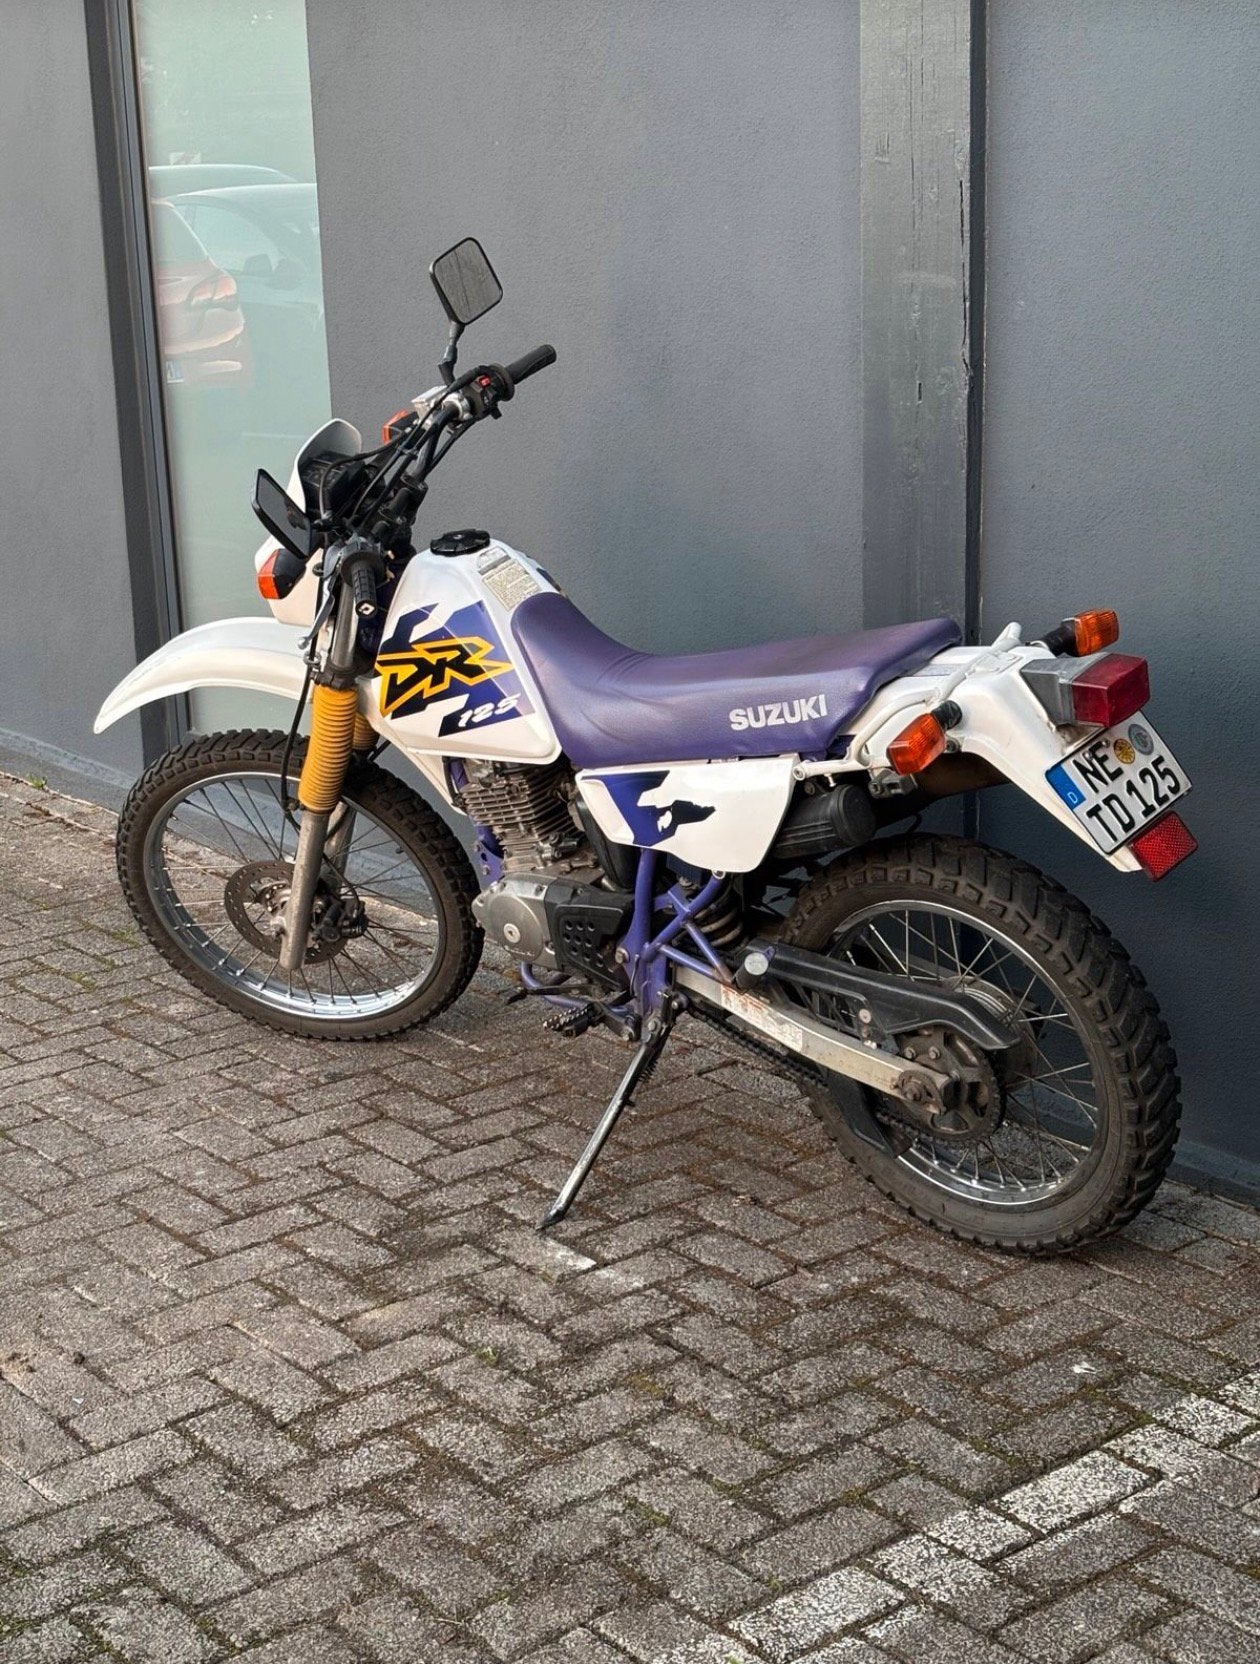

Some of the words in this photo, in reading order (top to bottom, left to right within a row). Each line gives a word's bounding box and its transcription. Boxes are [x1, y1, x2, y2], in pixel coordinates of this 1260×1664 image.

[375, 636, 515, 718] DR
[458, 692, 521, 728] 125
[729, 694, 828, 731] SUZUKI
[1072, 739, 1124, 794] NE
[1067, 792, 1079, 804] D
[1086, 793, 1136, 843] TD
[1125, 755, 1181, 818] 125
